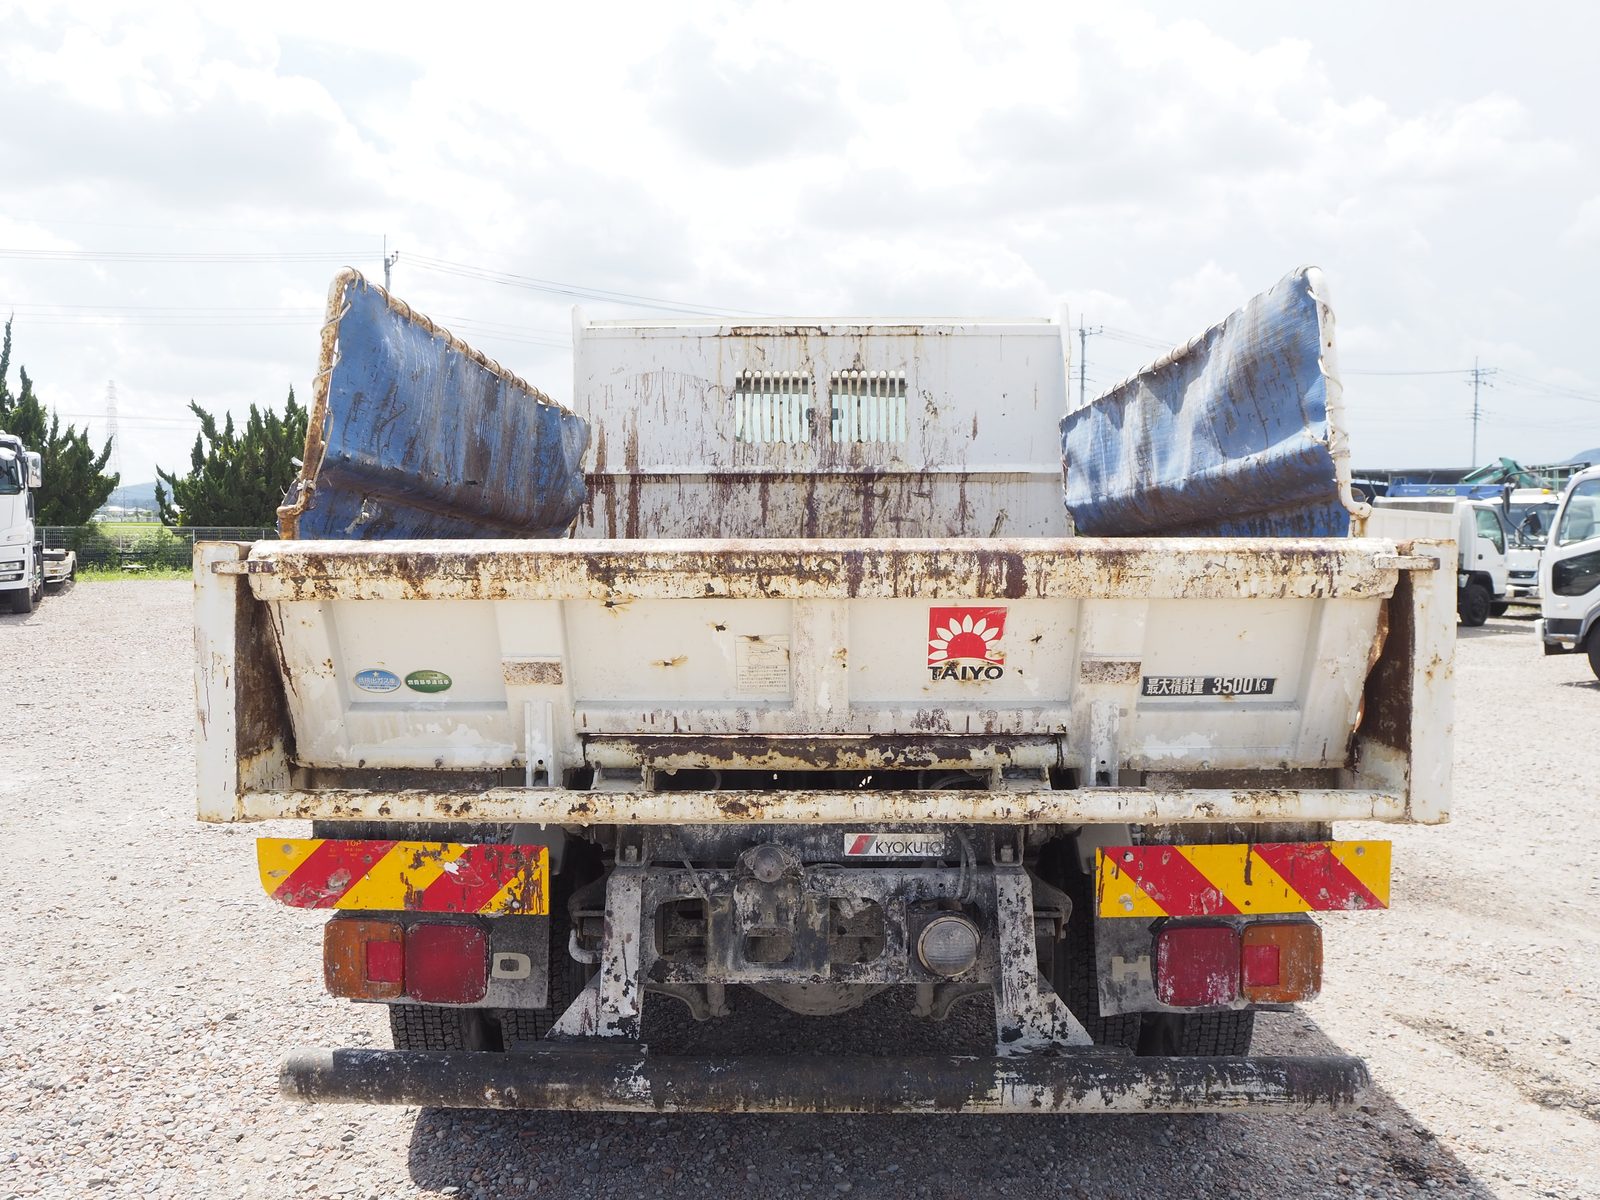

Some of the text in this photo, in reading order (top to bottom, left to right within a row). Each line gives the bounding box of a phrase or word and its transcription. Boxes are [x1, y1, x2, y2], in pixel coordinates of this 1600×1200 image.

[928, 666, 1004, 680] TAIYO
[1146, 678, 1204, 694] 最大積載量
[875, 841, 942, 855] KYOKUTO
